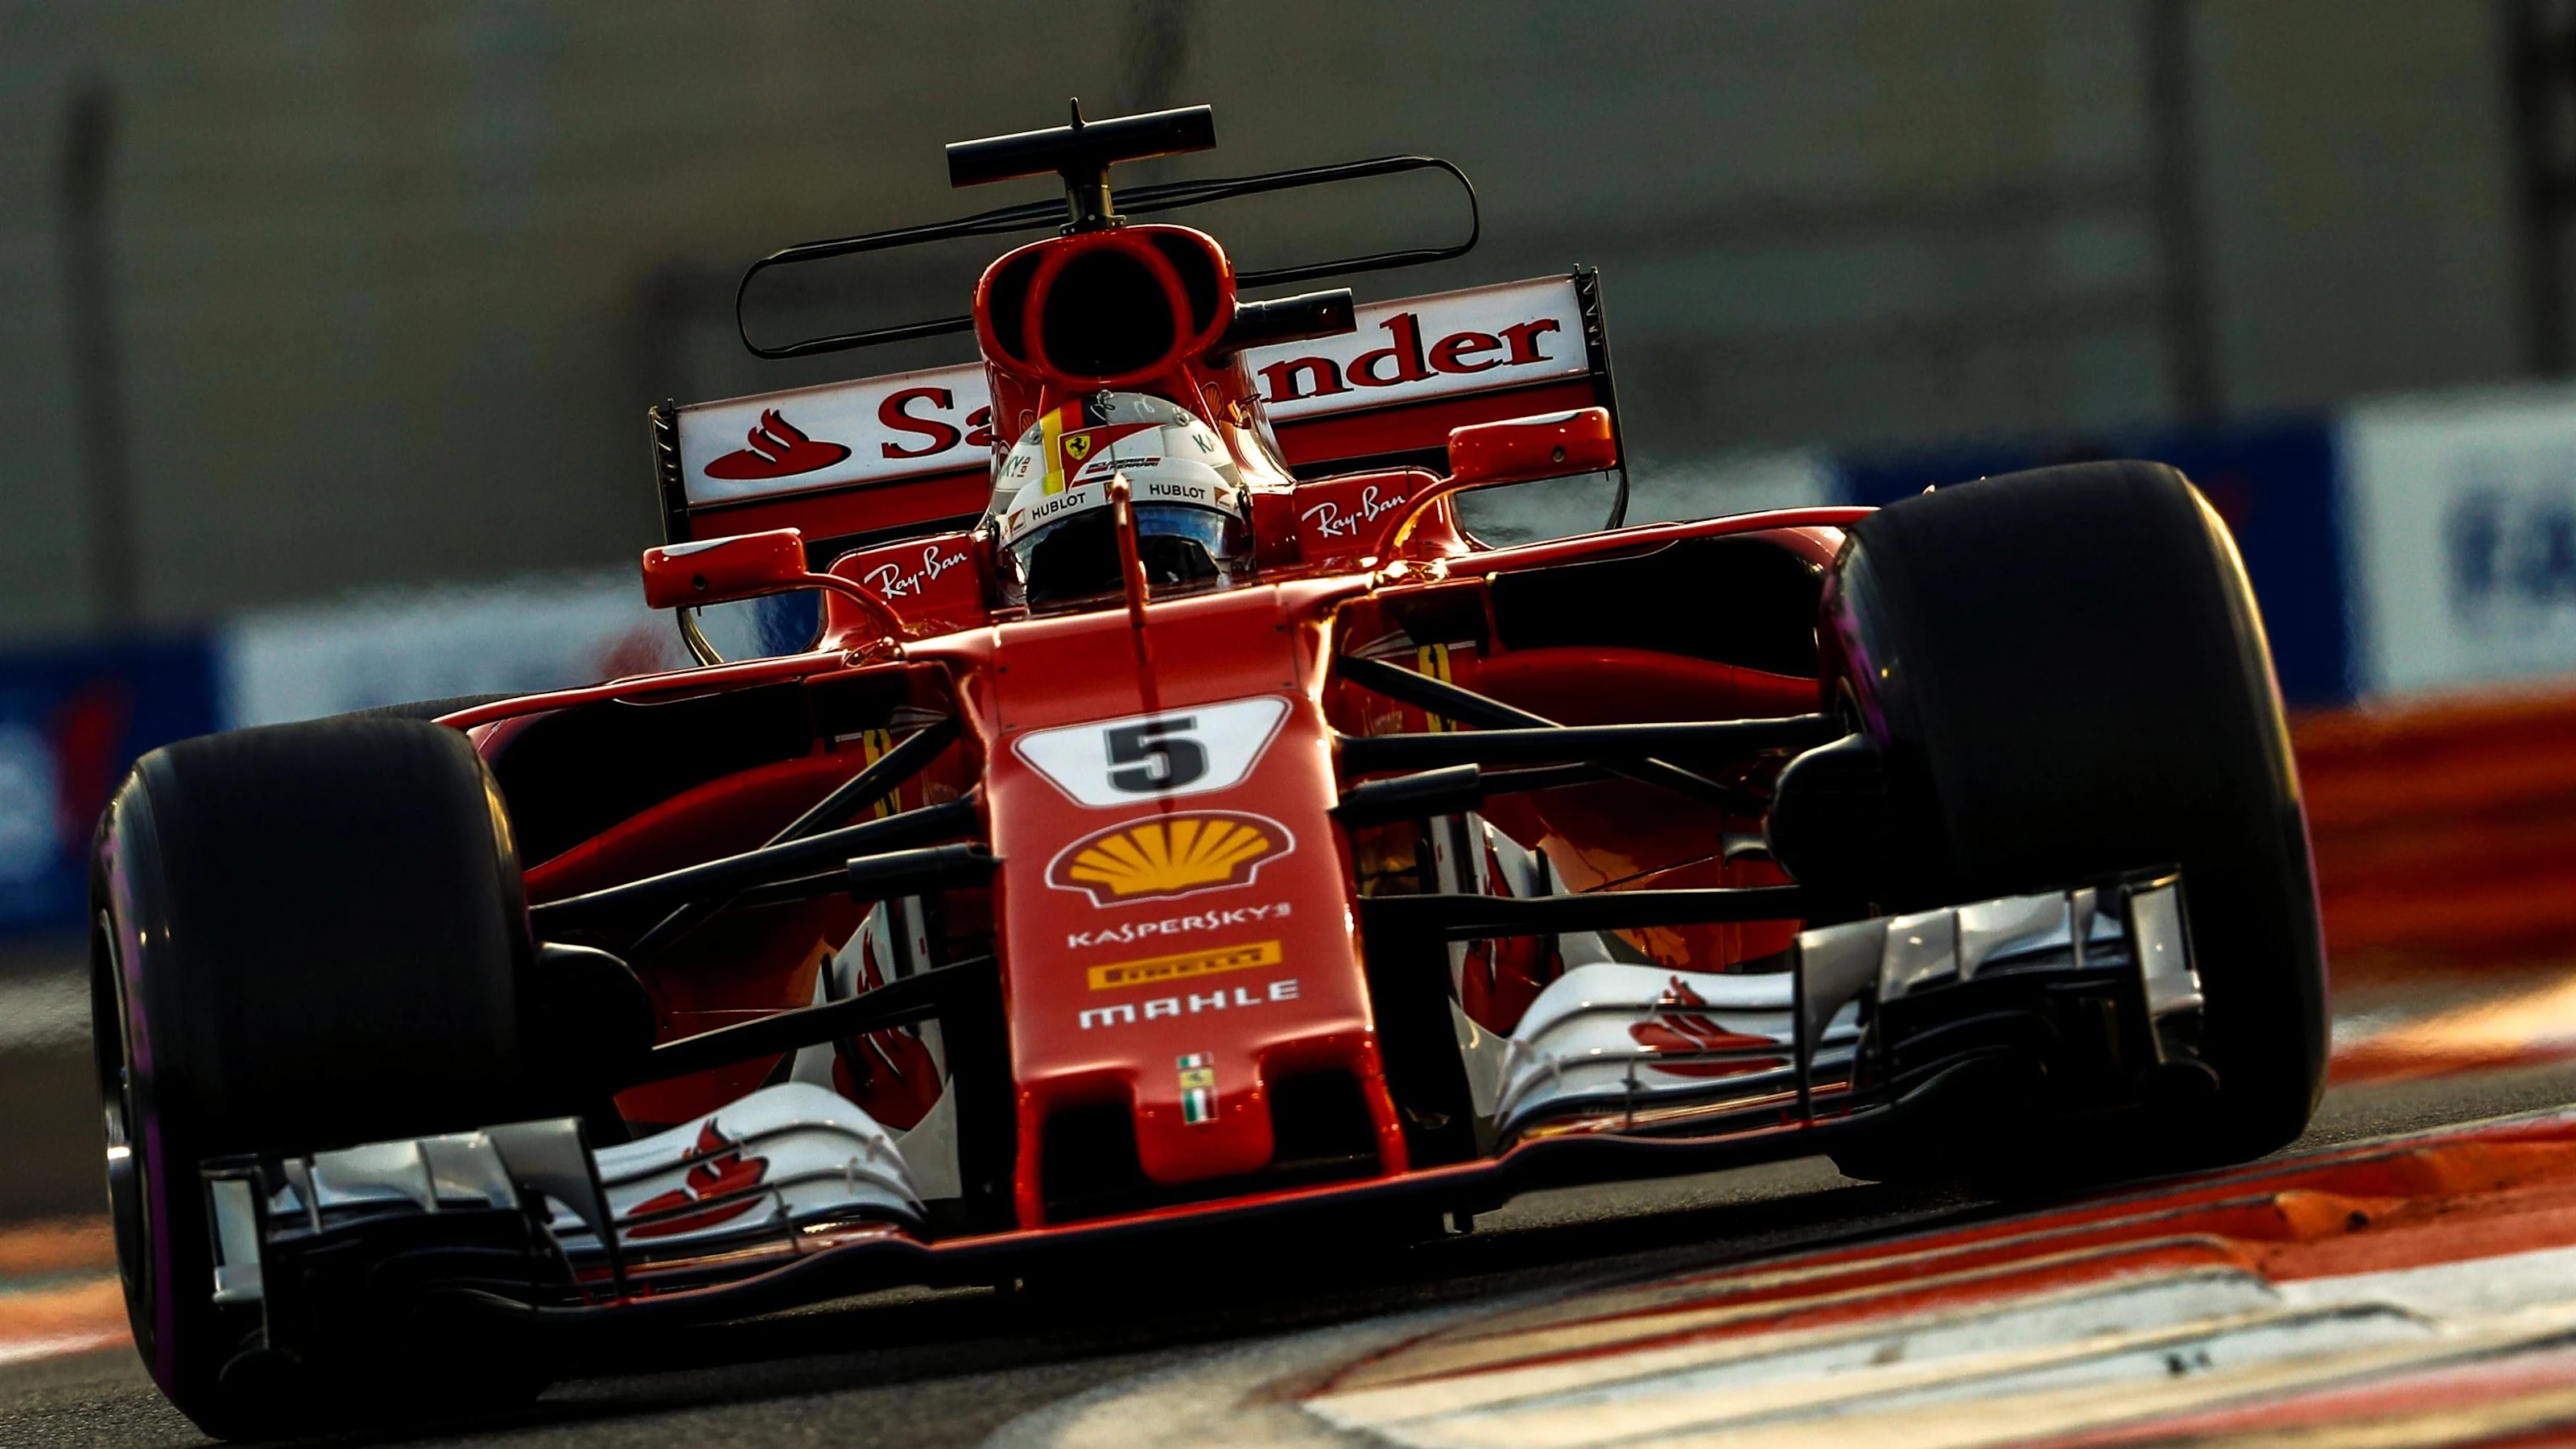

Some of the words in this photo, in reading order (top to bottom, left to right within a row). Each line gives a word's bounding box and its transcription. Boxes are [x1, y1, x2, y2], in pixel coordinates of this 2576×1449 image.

[1031, 493, 1086, 520] HUBLOT
[1150, 484, 1206, 499] HUBLOT
[1302, 485, 1406, 538] Ray-Ban
[864, 546, 968, 599] Ray-Ban
[1103, 715, 1209, 793] 5
[1067, 904, 1271, 948] KASPERSKY
[1079, 979, 1300, 1030] MAHLE
